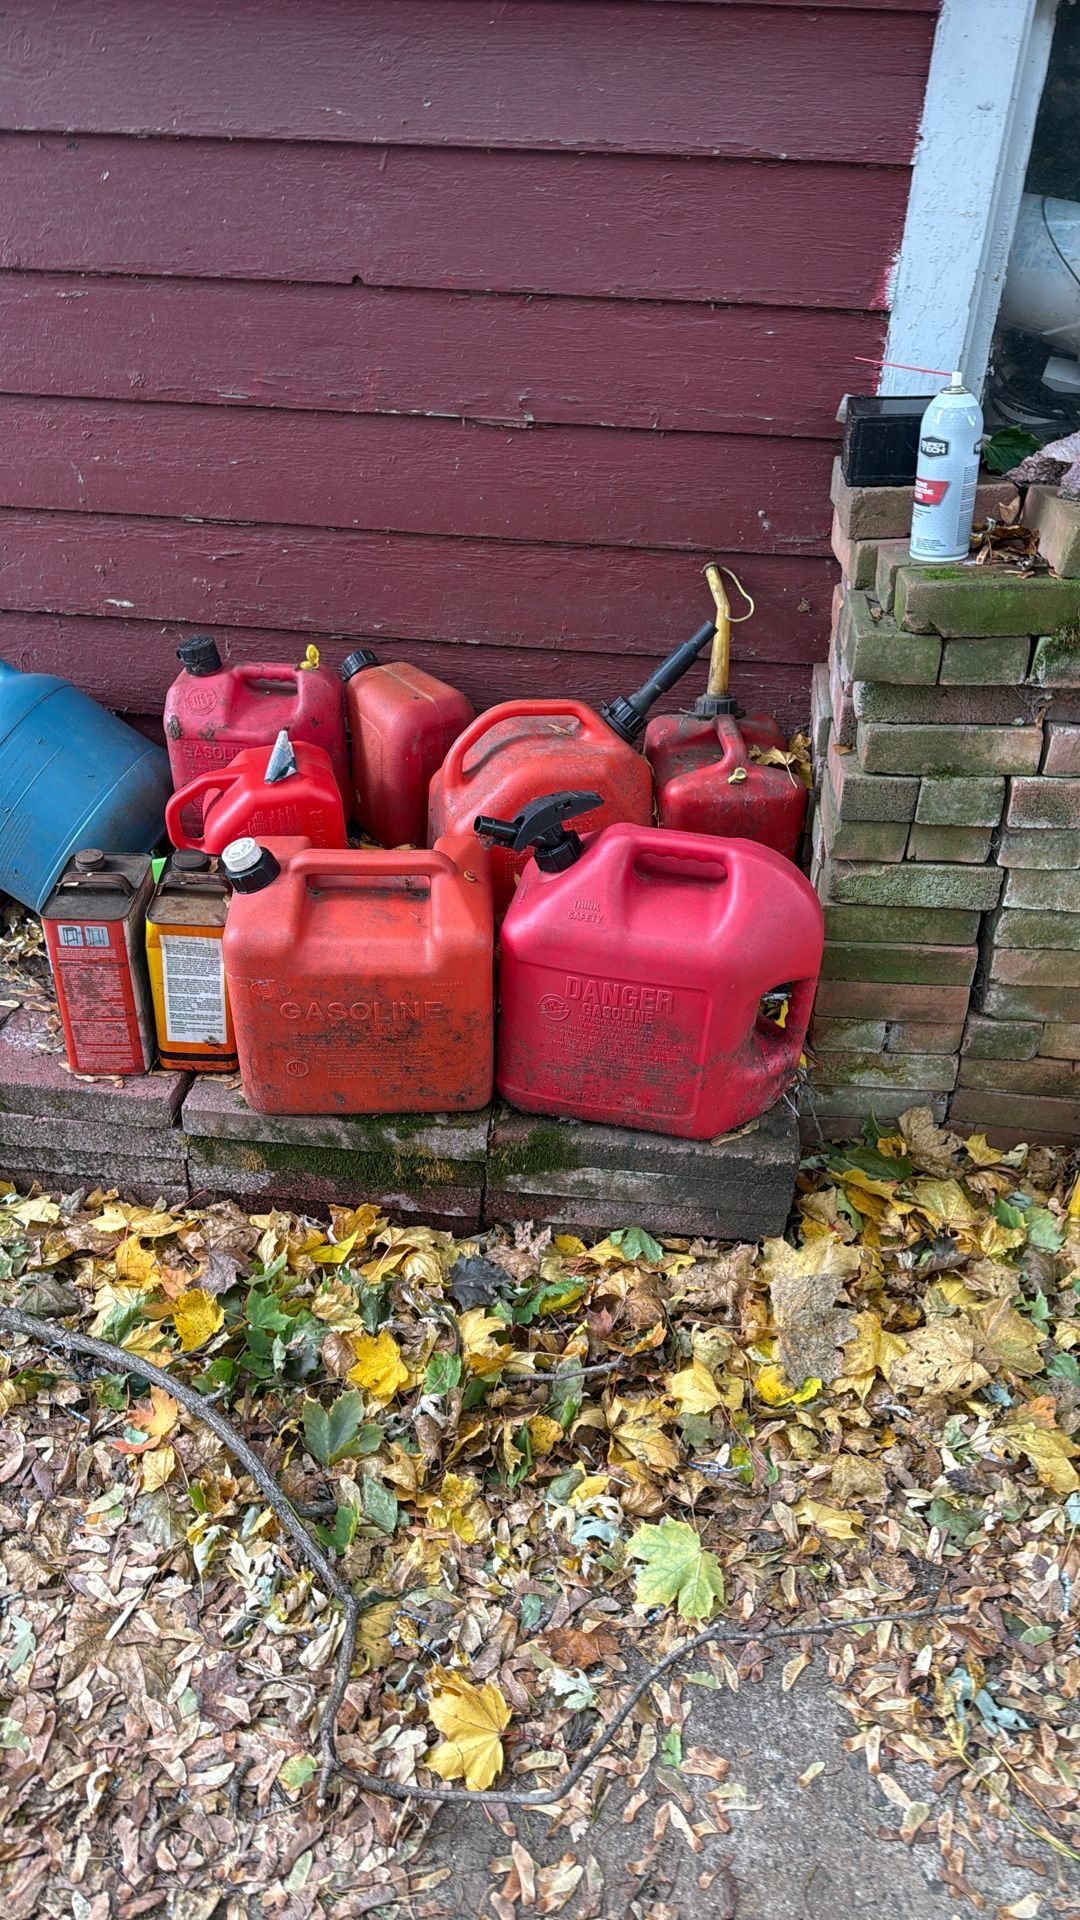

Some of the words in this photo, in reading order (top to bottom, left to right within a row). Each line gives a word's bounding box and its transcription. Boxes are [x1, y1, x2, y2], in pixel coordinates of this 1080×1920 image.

[921, 445, 946, 454] TECH
[573, 900, 601, 911] THINK
[567, 911, 604, 924] SAFETY
[564, 975, 676, 1014] DANGER
[279, 1001, 444, 1022] GASOLINE
[581, 1002, 655, 1022] GASOLINE
[290, 1062, 303, 1075] UL
